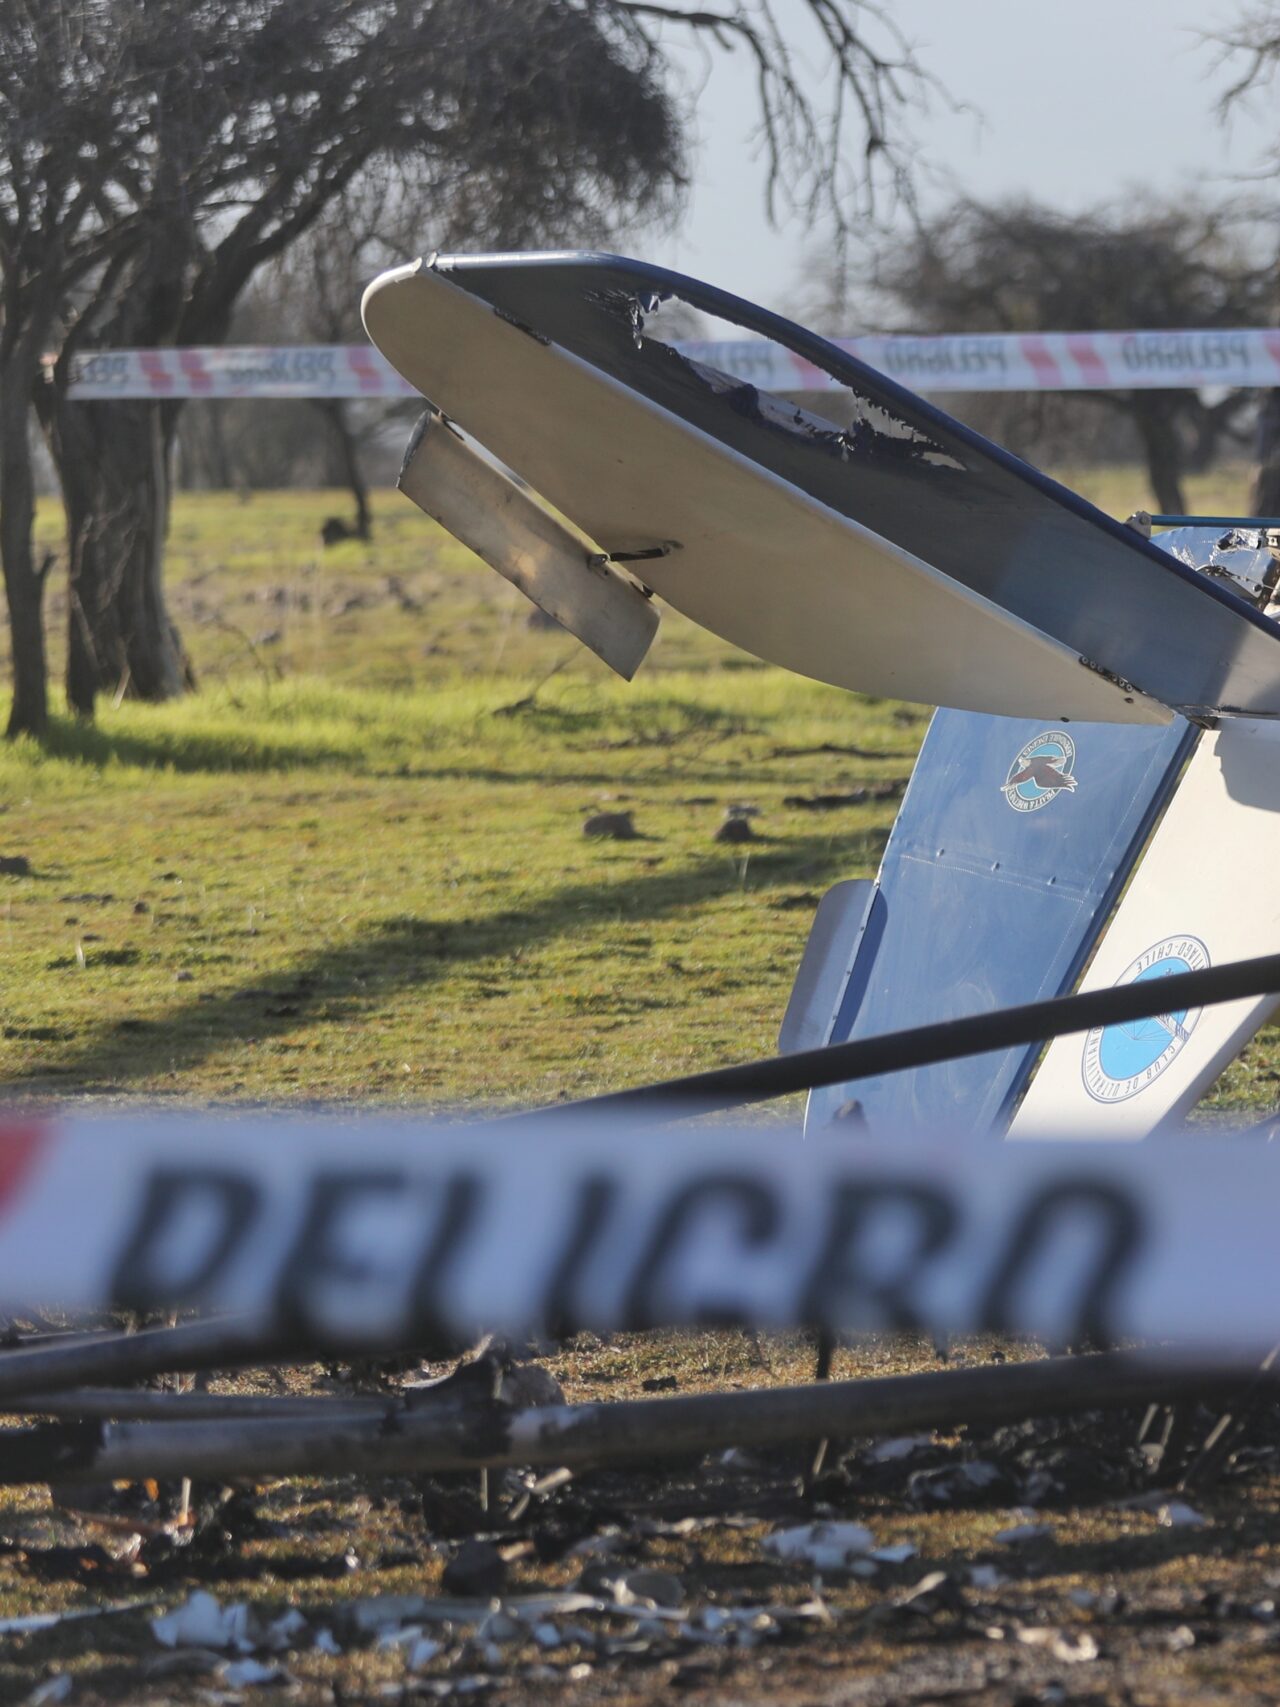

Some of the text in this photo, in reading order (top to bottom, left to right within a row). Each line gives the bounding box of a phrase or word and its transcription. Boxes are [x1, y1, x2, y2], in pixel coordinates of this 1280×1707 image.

[1085, 1024, 1176, 1097] CLUB DE ULTRALIVIANO
[105, 1155, 1158, 1350] PELIGRO
